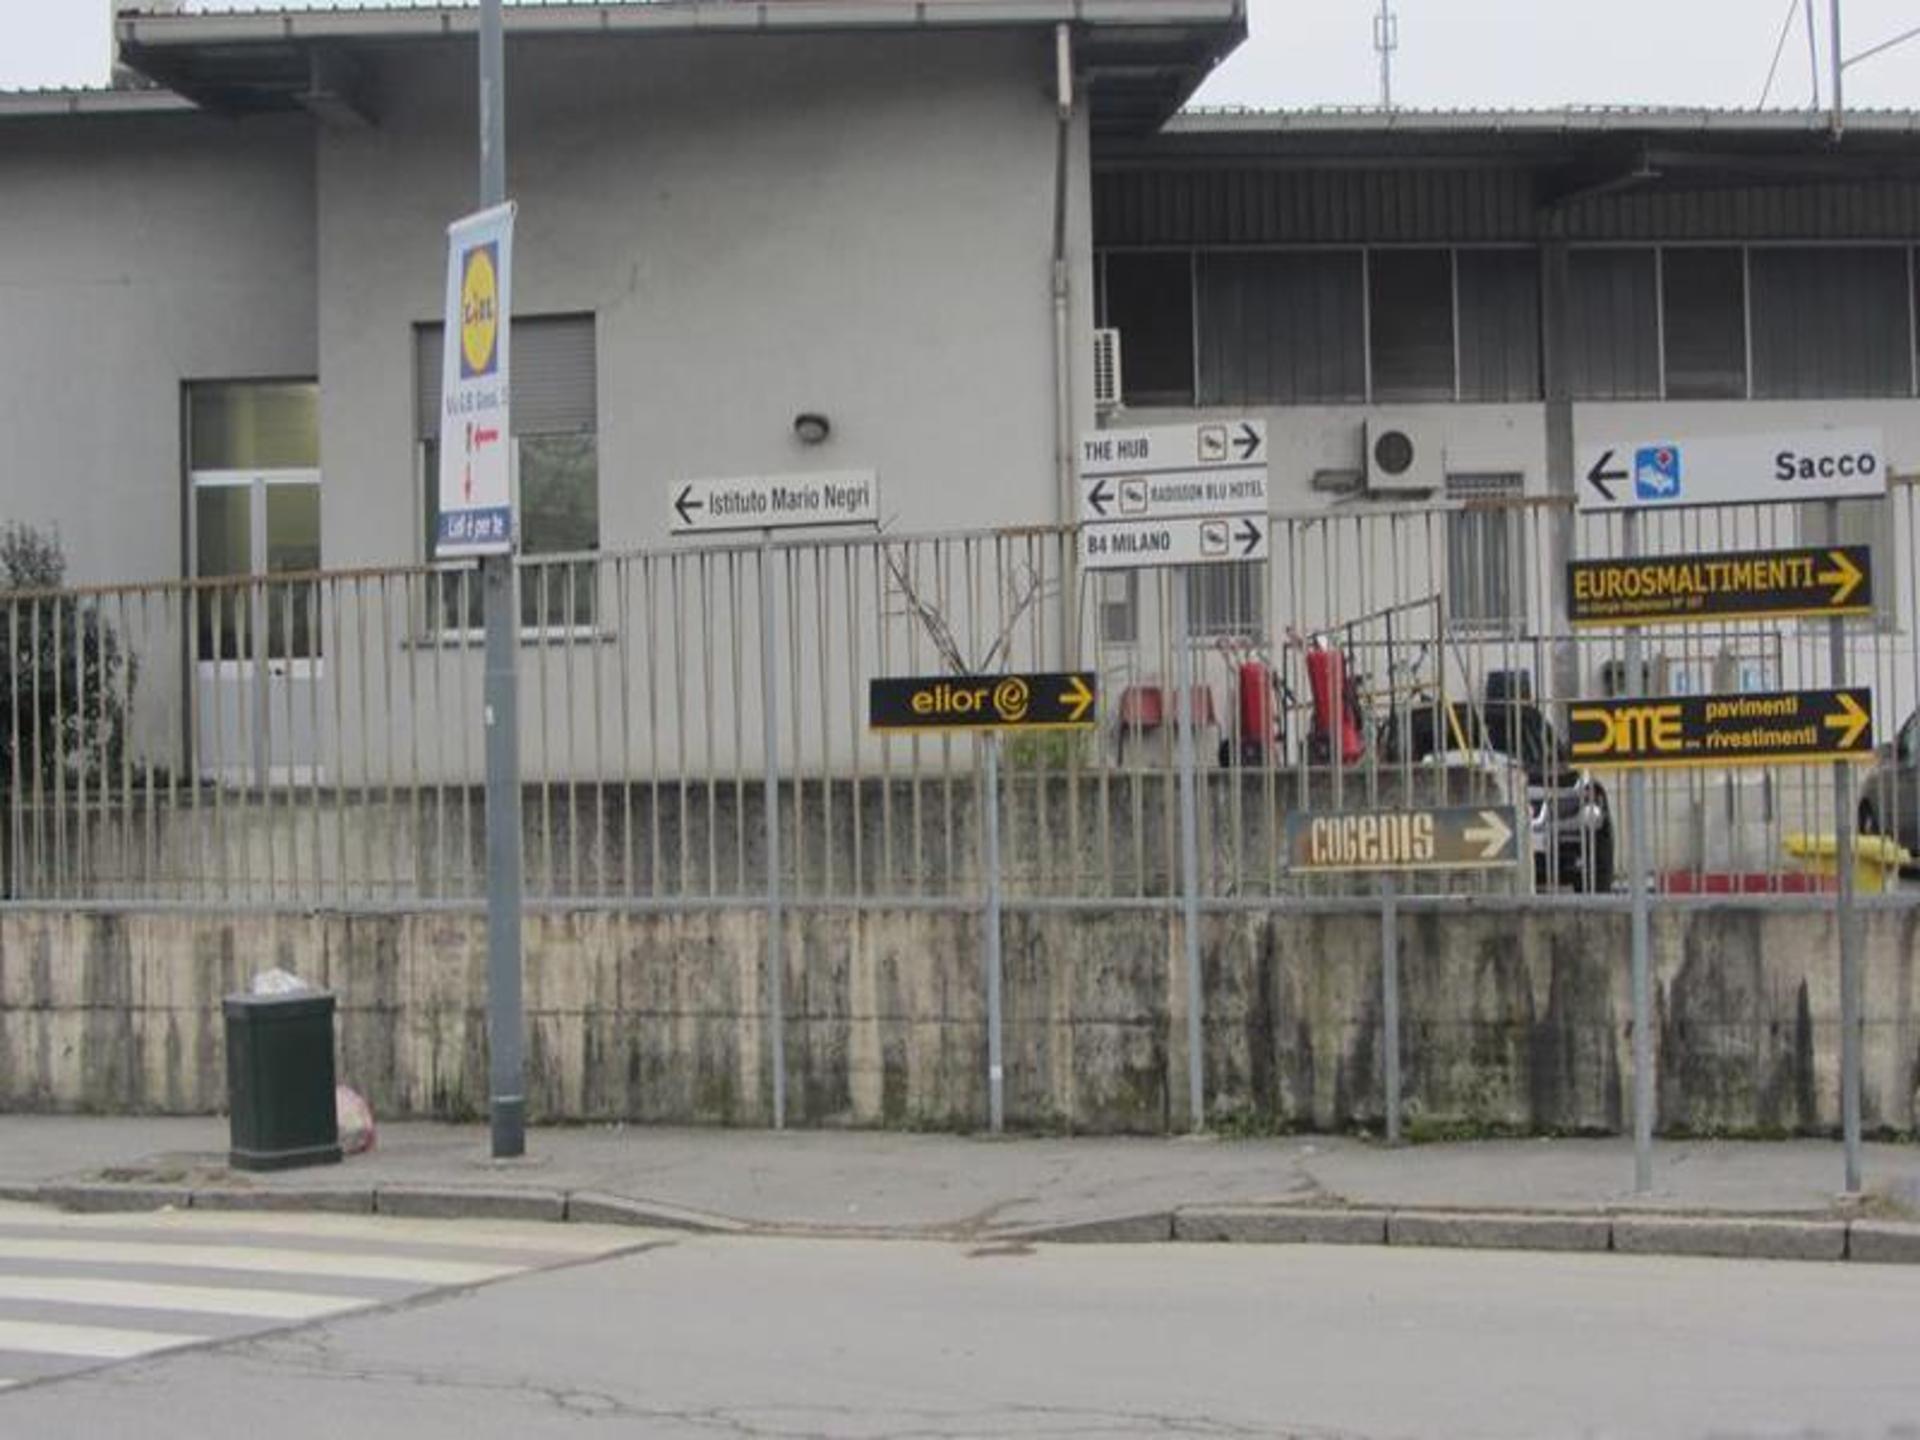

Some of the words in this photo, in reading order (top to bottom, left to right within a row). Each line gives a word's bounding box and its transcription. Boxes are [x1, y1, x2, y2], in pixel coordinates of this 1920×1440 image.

[1084, 441, 1112, 461] THE
[1118, 438, 1148, 459] HUB
[1775, 452, 1876, 481] Sacco
[709, 490, 767, 515] Istituto
[771, 483, 819, 511] Mario
[825, 480, 870, 513] Negri
[1206, 482, 1226, 500] BLU
[1229, 479, 1264, 498] HOTEL
[1088, 534, 1107, 553] B4
[1111, 529, 1170, 553] MILANO
[1574, 557, 1814, 598] EUROSMALTIMENTI
[1706, 698, 1798, 722] pavimenti
[1706, 725, 1818, 748] rivestimenti
